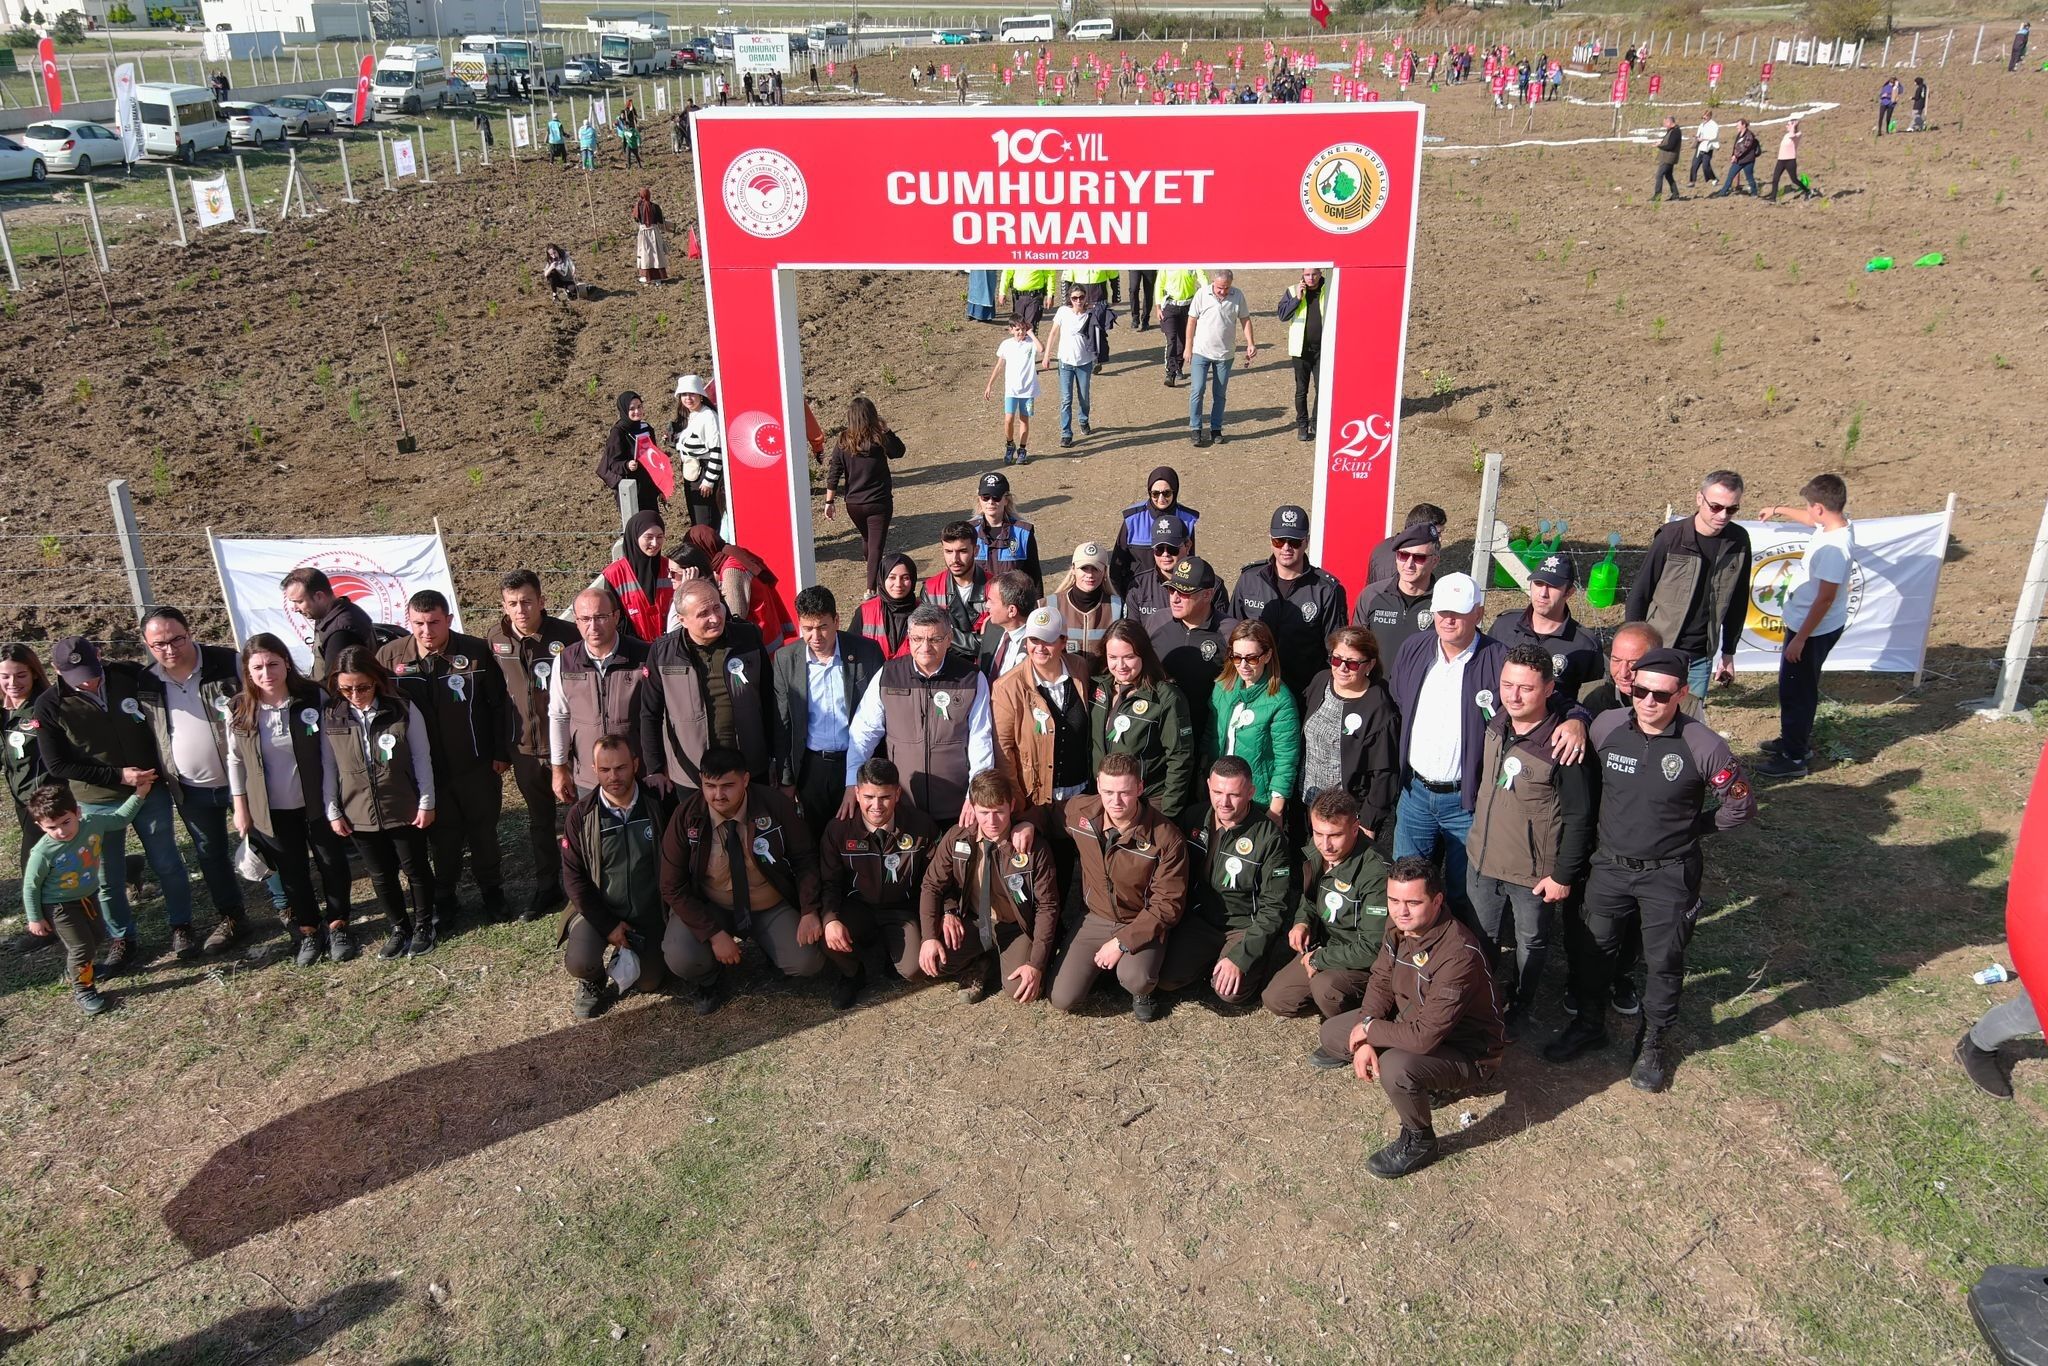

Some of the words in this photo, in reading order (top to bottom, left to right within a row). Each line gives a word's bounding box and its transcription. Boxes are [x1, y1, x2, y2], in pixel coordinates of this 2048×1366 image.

[748, 54, 777, 62] ORMANI
[1303, 172, 1314, 213] ORMAN
[1313, 146, 1348, 167] GENEL
[1324, 205, 1345, 220] OGM
[952, 211, 1148, 245] ORMANI
[1011, 250, 1022, 260] 11
[1024, 250, 1059, 260] Kasım
[1061, 250, 1089, 260] 2023
[1332, 414, 1391, 461] 29
[1331, 457, 1373, 472] Ekim
[1754, 544, 1805, 562] GENEL
